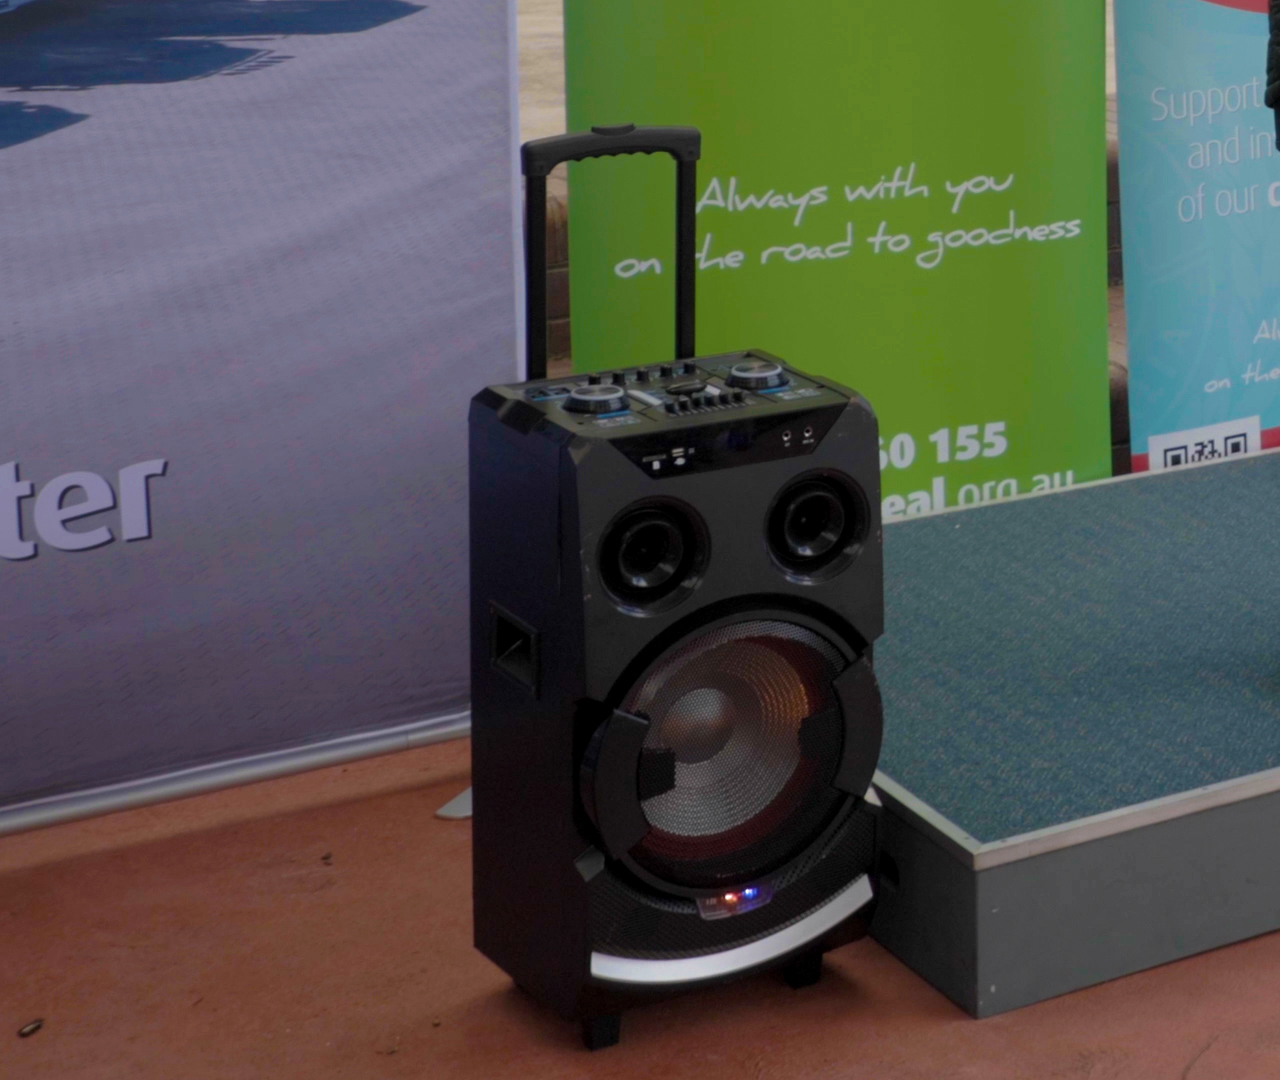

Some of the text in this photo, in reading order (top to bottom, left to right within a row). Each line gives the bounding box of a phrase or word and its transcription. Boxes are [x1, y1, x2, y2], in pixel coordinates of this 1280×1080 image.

[1151, 76, 1262, 127] Support
[1188, 126, 1240, 169] and
[695, 162, 1014, 227] Always with you
[1178, 182, 1206, 223] of
[1215, 184, 1260, 216] our
[614, 256, 661, 278] on
[760, 221, 854, 265] road
[866, 221, 911, 255] to
[916, 209, 1081, 270] goodness
[1204, 378, 1231, 393] on
[928, 421, 1008, 463] 155
